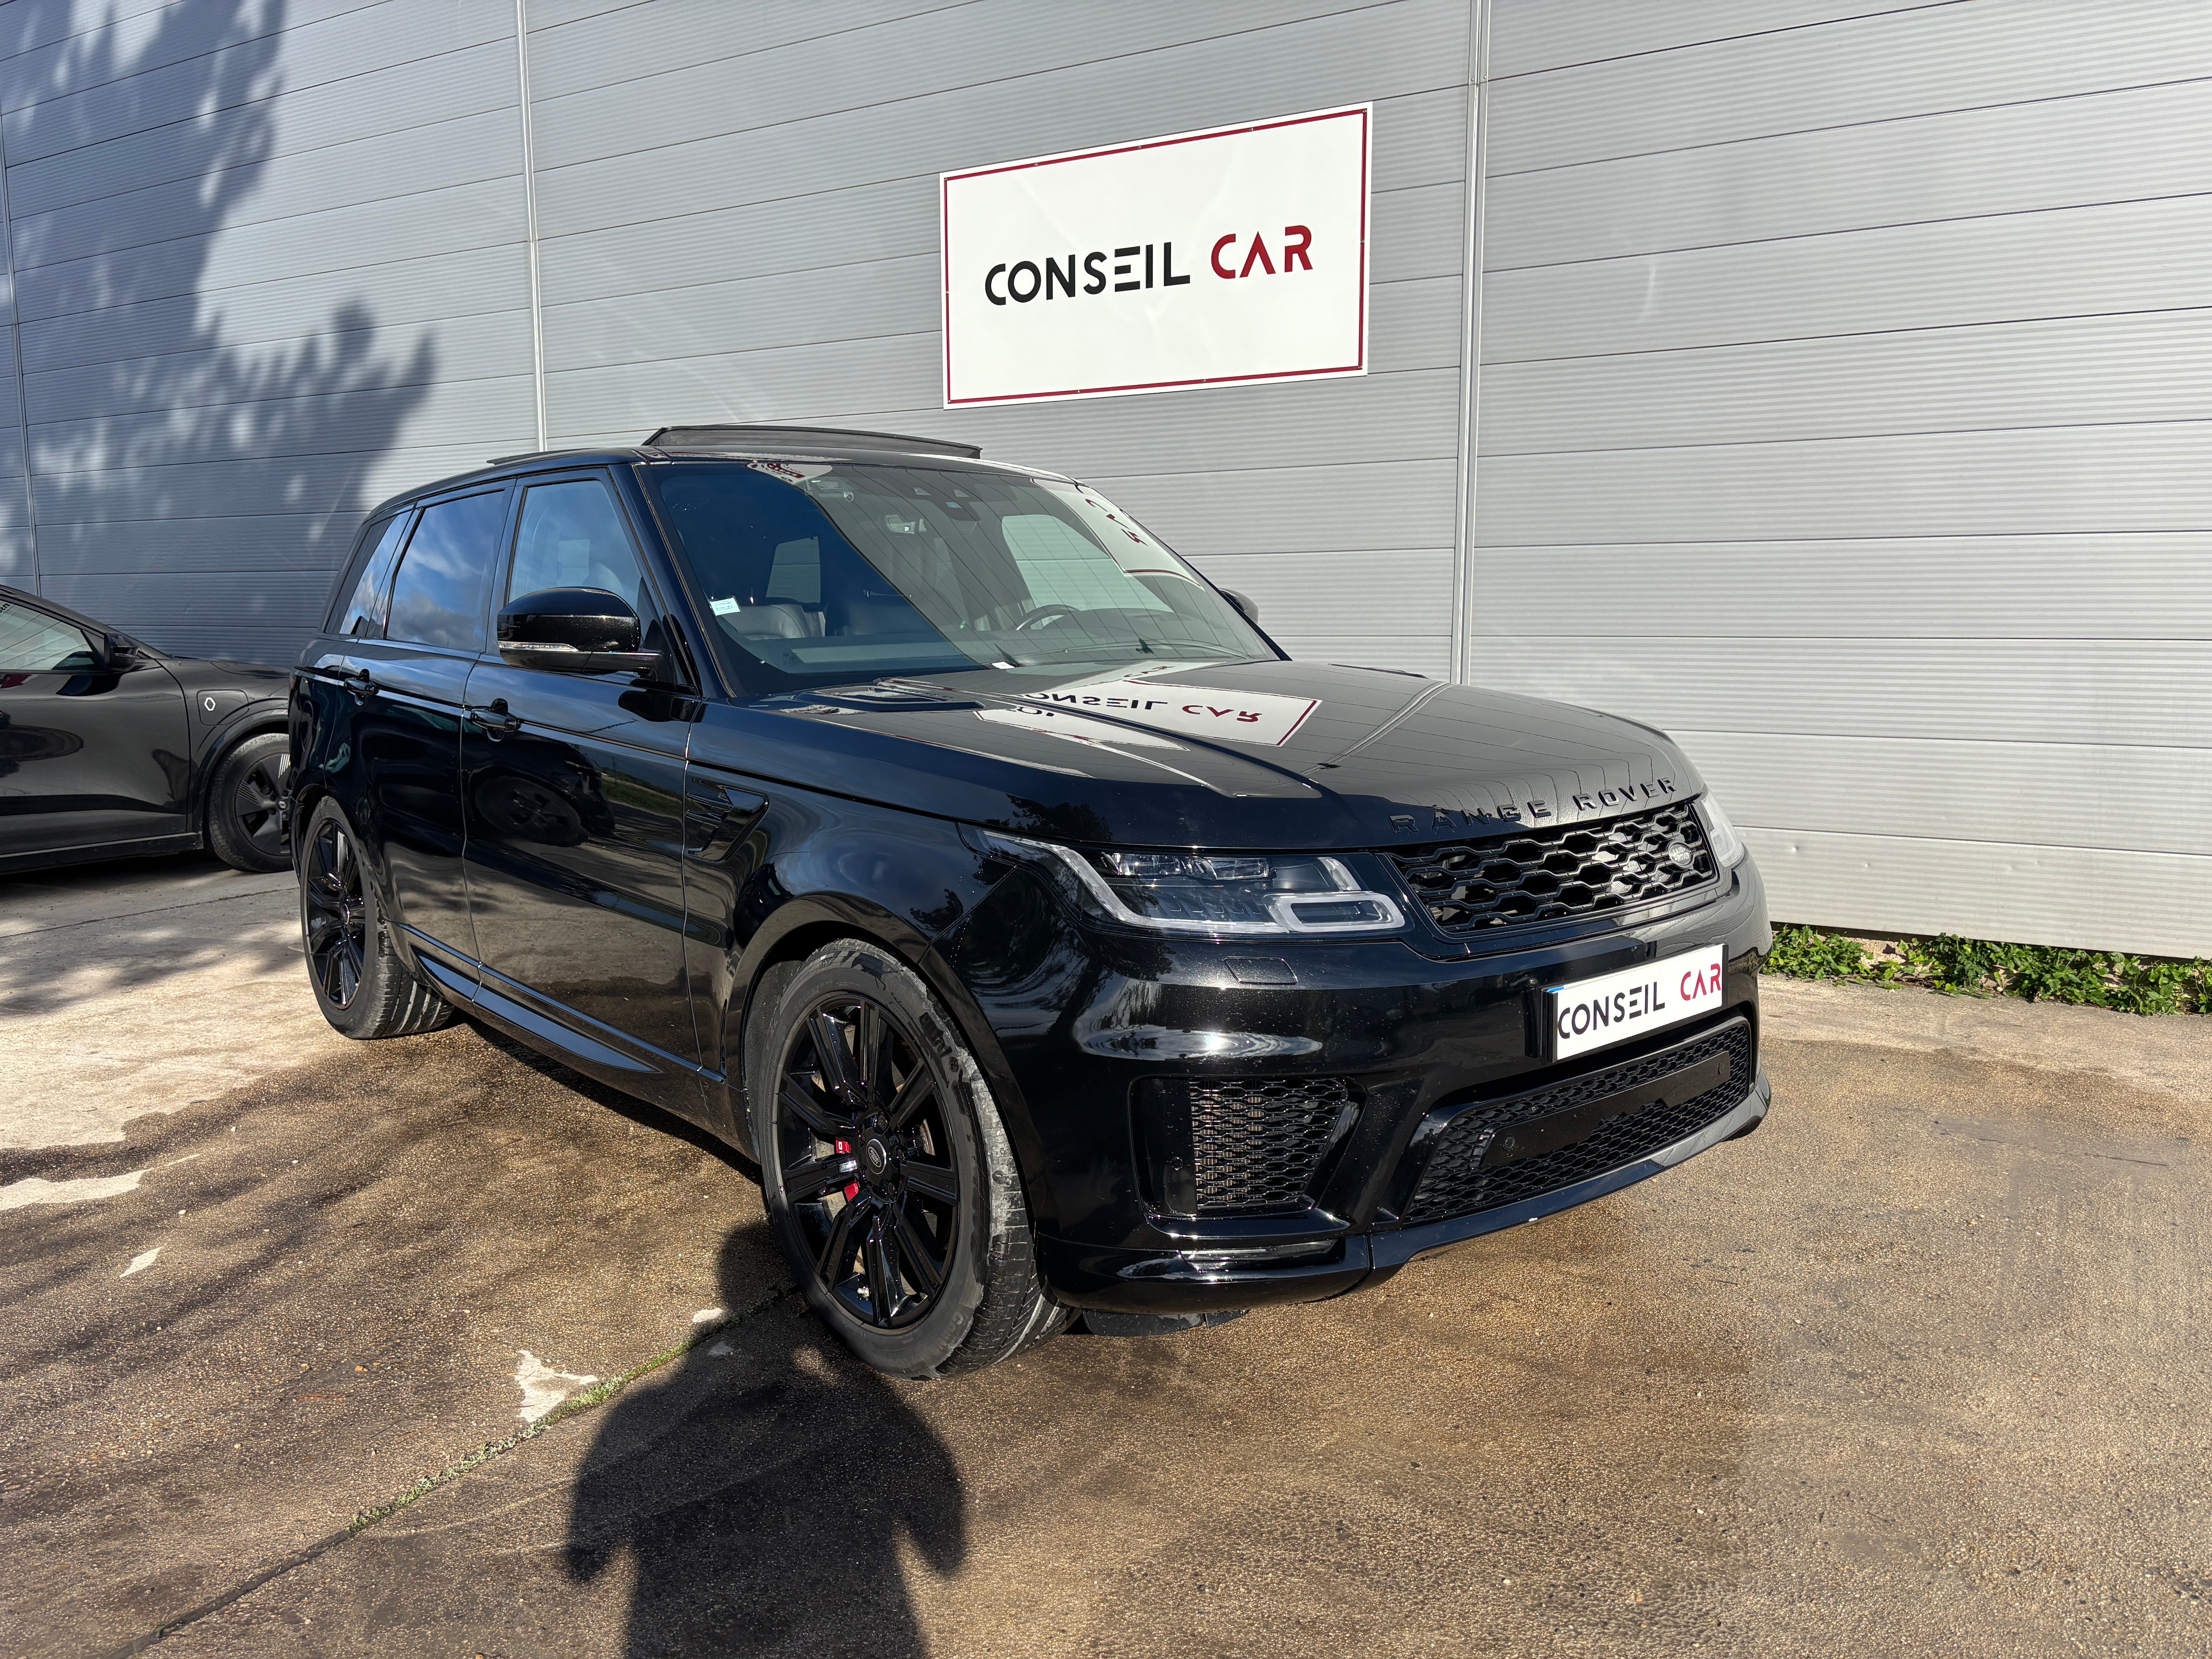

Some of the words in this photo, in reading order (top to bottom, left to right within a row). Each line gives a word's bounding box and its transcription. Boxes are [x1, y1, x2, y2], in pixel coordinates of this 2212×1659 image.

[985, 242, 1190, 305] CONSEIL
[1211, 225, 1313, 279] CAR
[1389, 800, 1551, 833] RANGE
[1572, 777, 1676, 811] ROVER
[1558, 981, 1665, 1039] CONSEIL
[1681, 963, 1721, 1001] CAR
